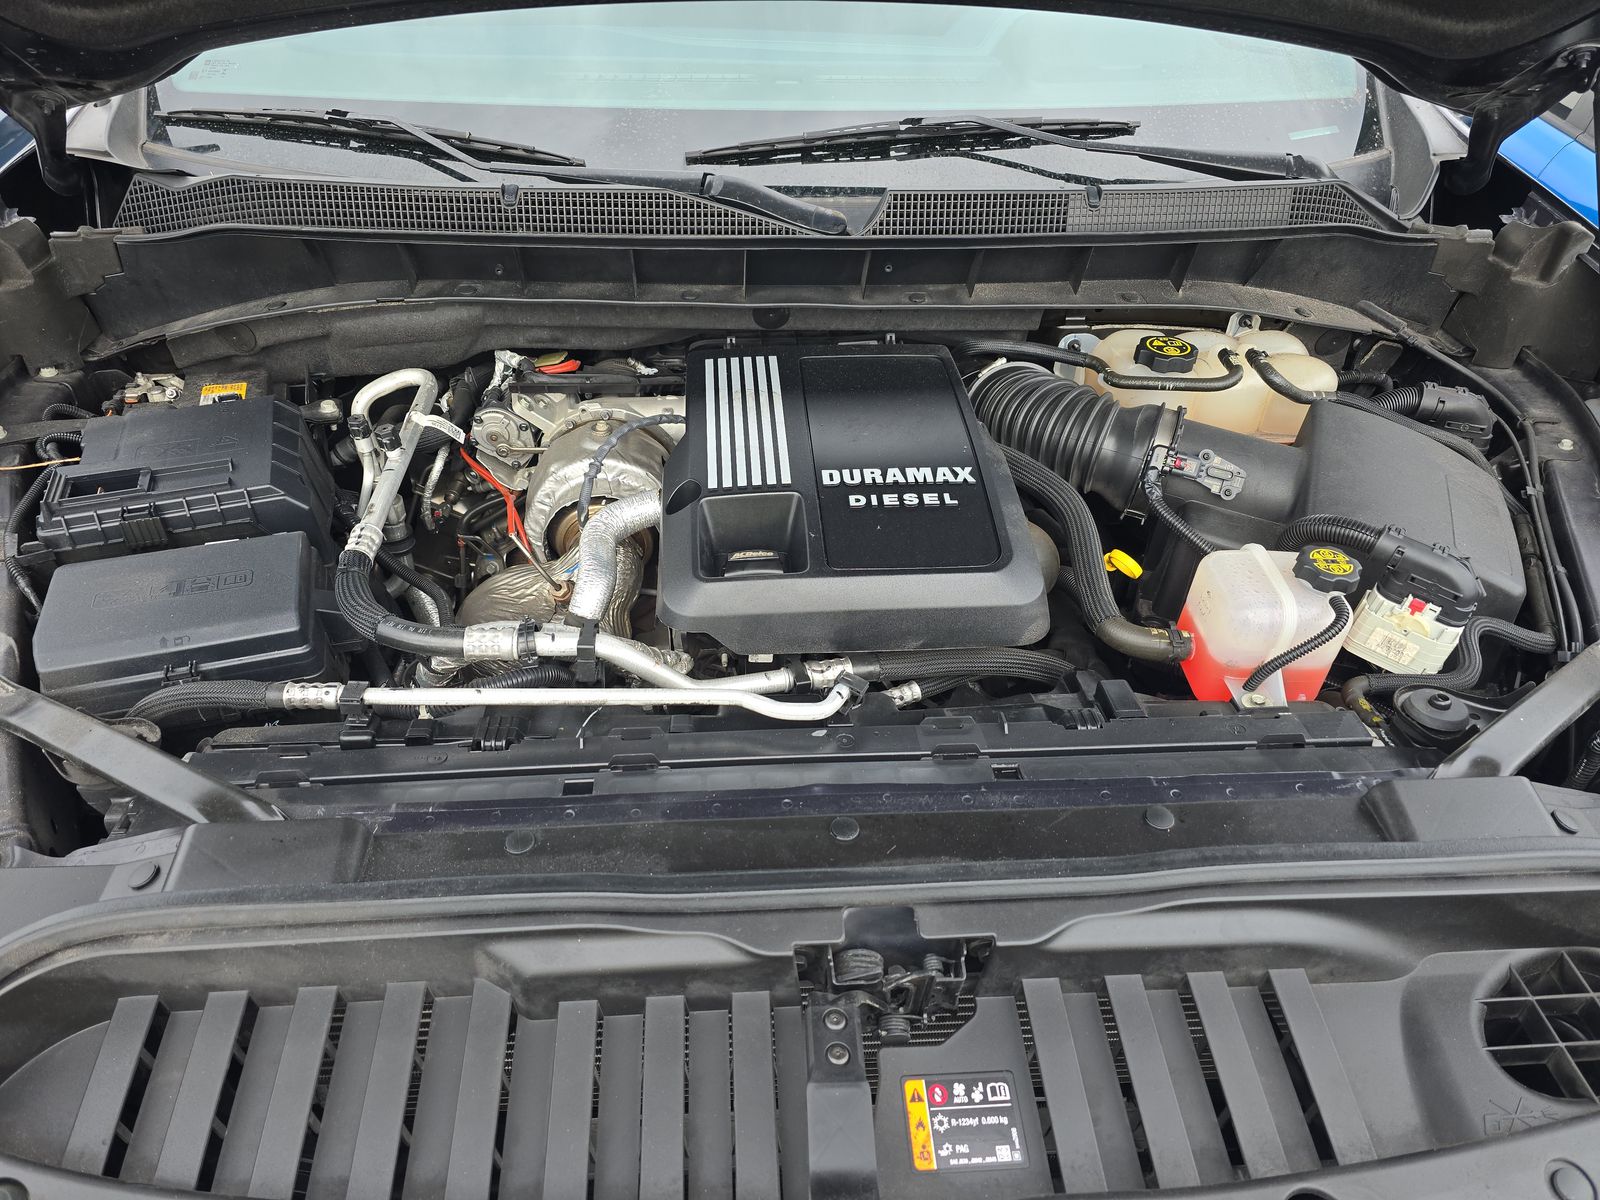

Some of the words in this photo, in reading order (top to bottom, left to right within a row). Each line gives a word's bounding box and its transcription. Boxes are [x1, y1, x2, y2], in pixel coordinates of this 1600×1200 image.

[821, 466, 977, 486] DURAMAX
[848, 492, 960, 508] DIESEL
[999, 1115, 1008, 1125] kg
[955, 1144, 969, 1153] PAG
